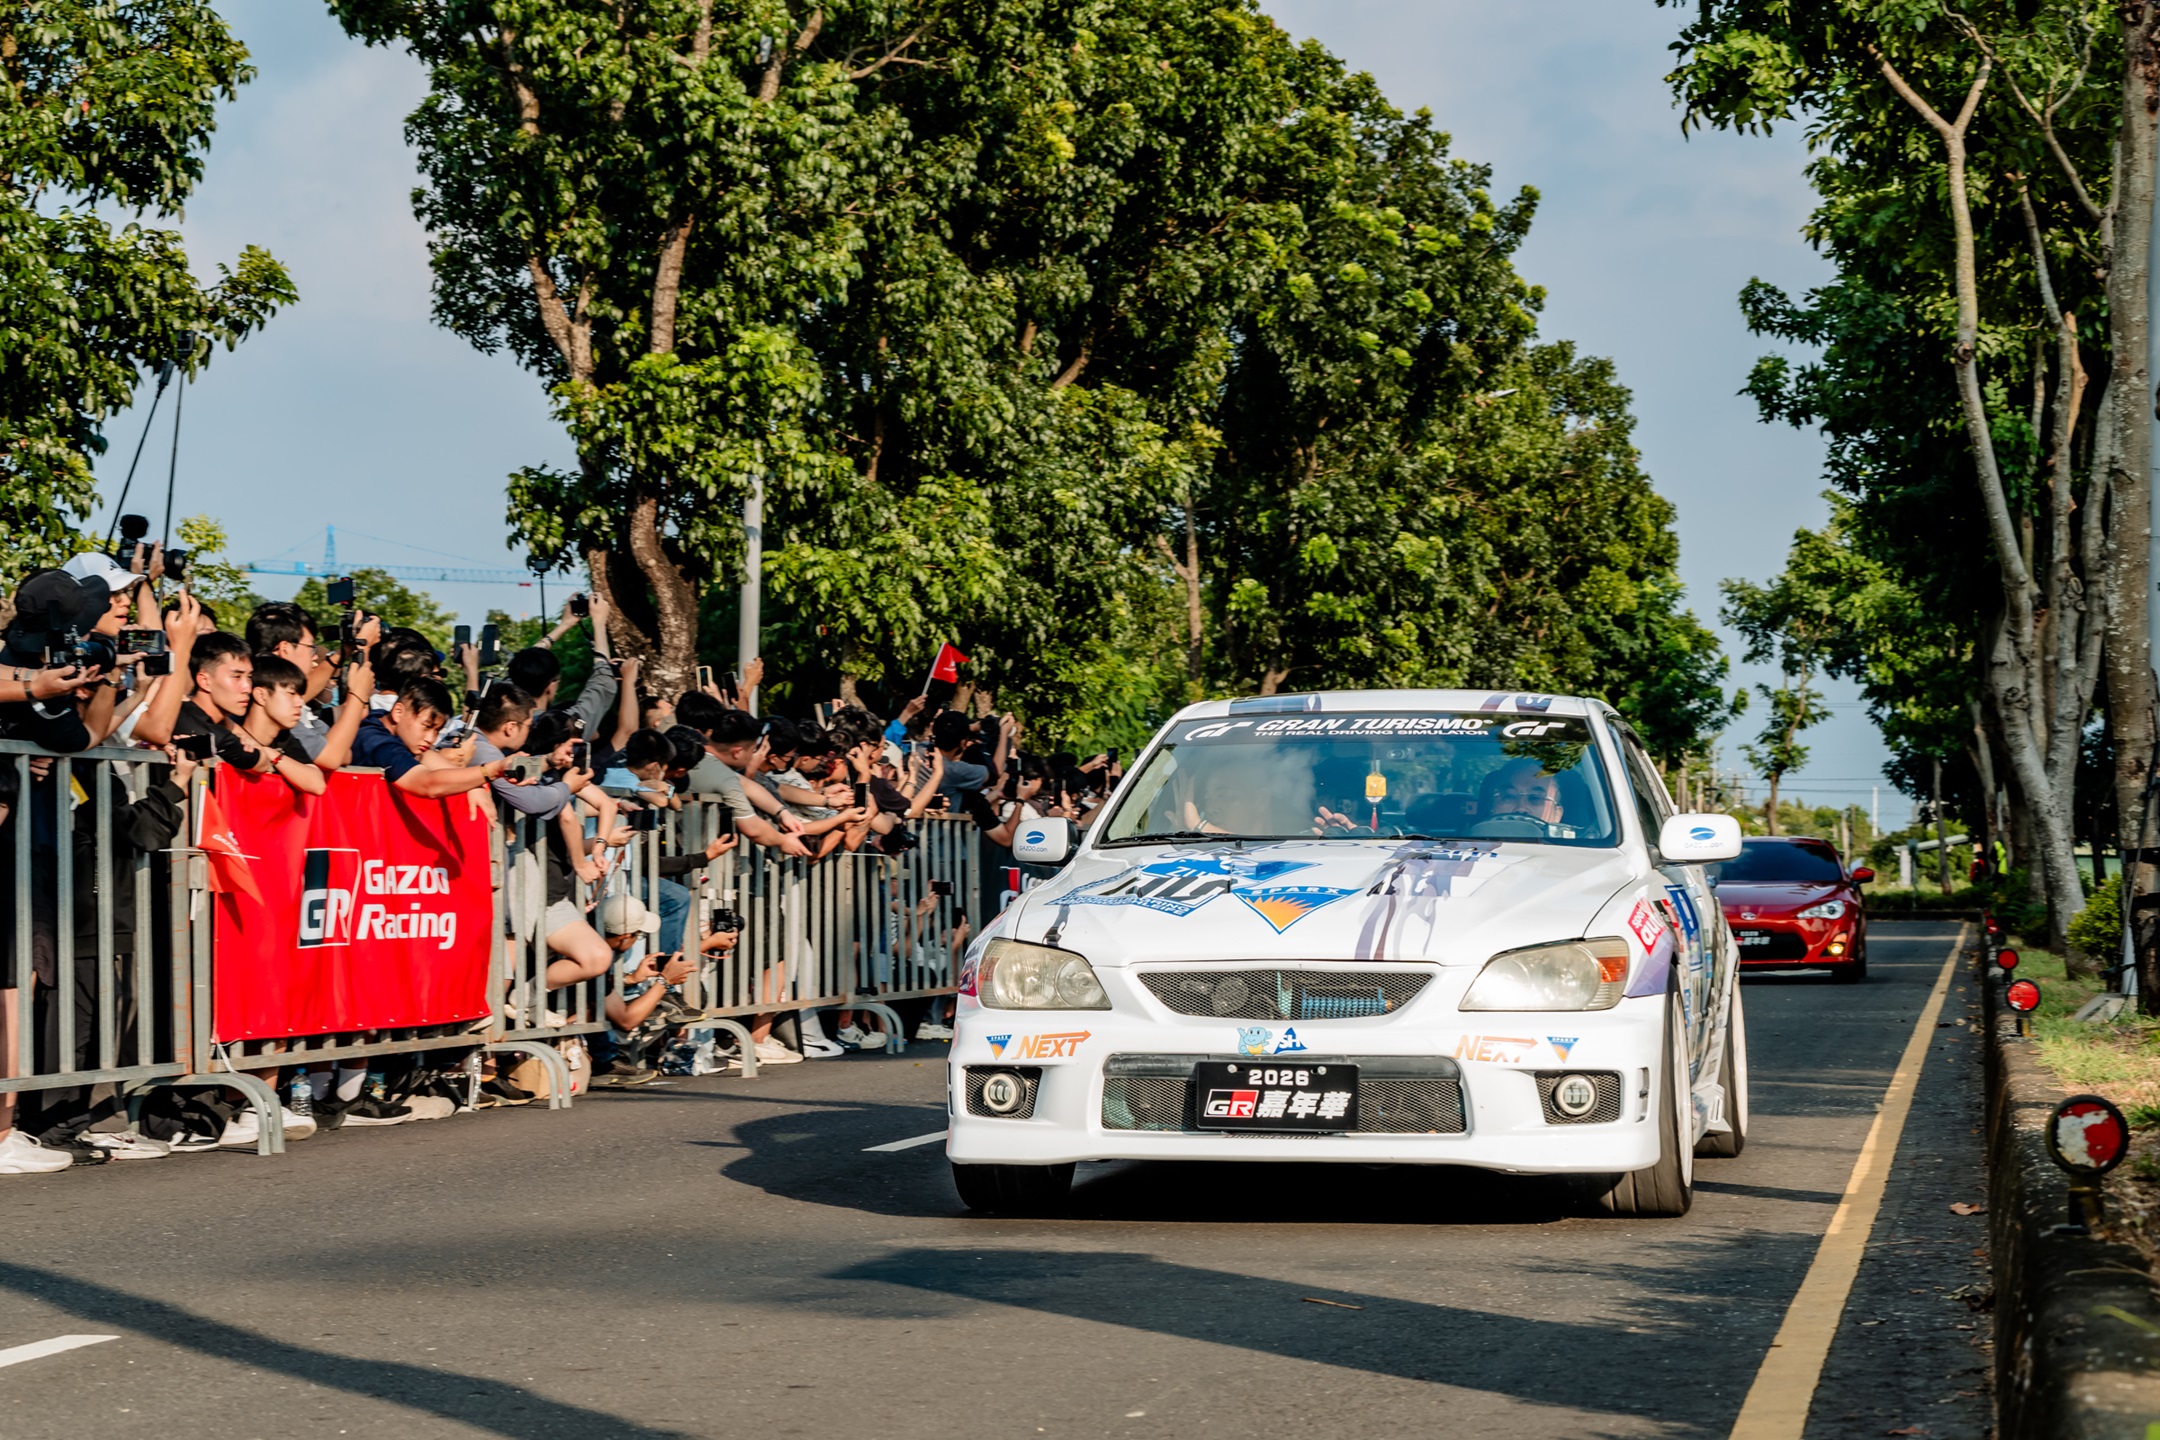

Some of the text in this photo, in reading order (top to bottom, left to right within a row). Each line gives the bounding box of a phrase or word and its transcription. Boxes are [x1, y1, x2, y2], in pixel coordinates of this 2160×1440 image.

[1255, 718, 1347, 731] GRAN
[363, 859, 450, 895] GAZOO
[1251, 887, 1339, 895] SPARX
[301, 888, 351, 940] GR
[356, 902, 457, 950] Racing
[1011, 1033, 1083, 1059] NEXT
[1280, 1034, 1301, 1049] SH
[1248, 1069, 1310, 1086] 2026
[1207, 1089, 1352, 1119] GR 嘉年華
